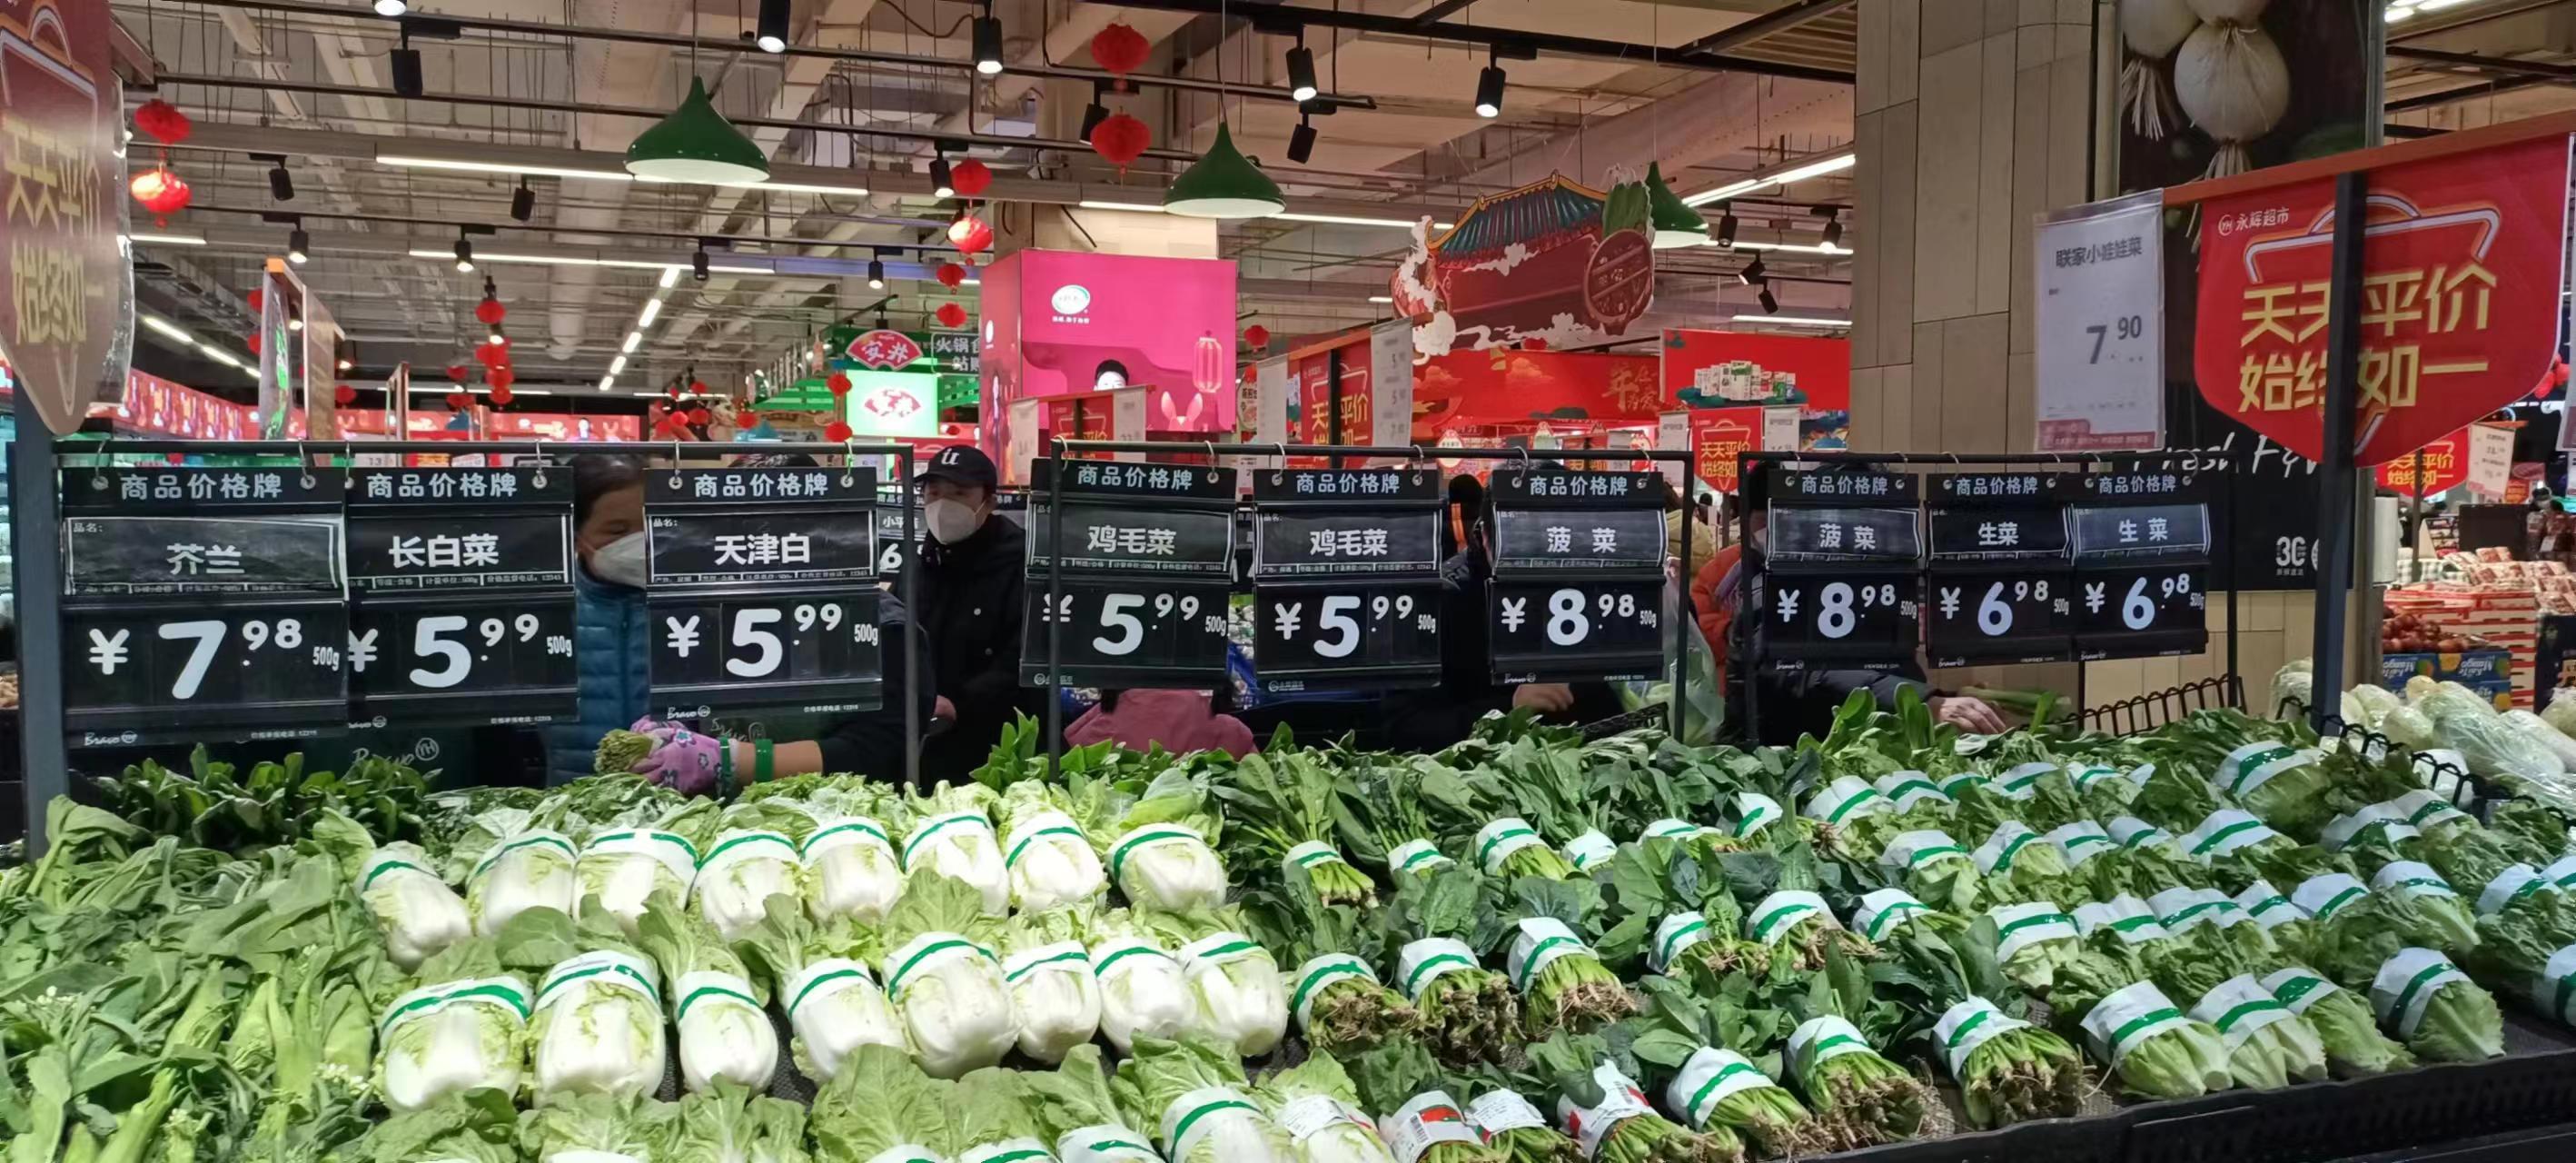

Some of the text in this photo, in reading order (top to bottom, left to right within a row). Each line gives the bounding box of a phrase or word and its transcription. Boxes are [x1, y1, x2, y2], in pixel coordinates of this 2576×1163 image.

[2235, 207, 2289, 231] 永辉超市
[1078, 465, 1193, 491] 商品价格牌
[1701, 460, 1738, 477] 始终如
[121, 473, 282, 500] 商品价格牌
[367, 472, 517, 498] 商品价格牌
[694, 472, 828, 497] 商品价格牌
[1297, 473, 1399, 493] 商品价格牌
[1531, 475, 1628, 495] 商品价格牌
[1802, 475, 1887, 494] 商品价格牌
[1957, 477, 2037, 495] 商品价格牌
[2099, 475, 2175, 493] 商品价格牌
[1088, 525, 1176, 554] 鸡毛菜
[1547, 527, 1616, 552] 菠菜
[1820, 523, 1875, 549] 菠菜
[1979, 522, 2017, 545] 生菜
[2119, 518, 2167, 542] 生菜
[389, 533, 498, 568] 长白菜
[715, 533, 809, 564] 天津白
[1311, 529, 1387, 556] 鸡毛菜
[167, 543, 243, 574] 芥兰
[1205, 616, 1226, 636] 500g
[1418, 615, 1435, 633] 500g
[1640, 611, 1656, 628] 500g
[547, 636, 572, 657] 500g
[855, 624, 878, 646] 500g
[312, 647, 340, 671] 500g
